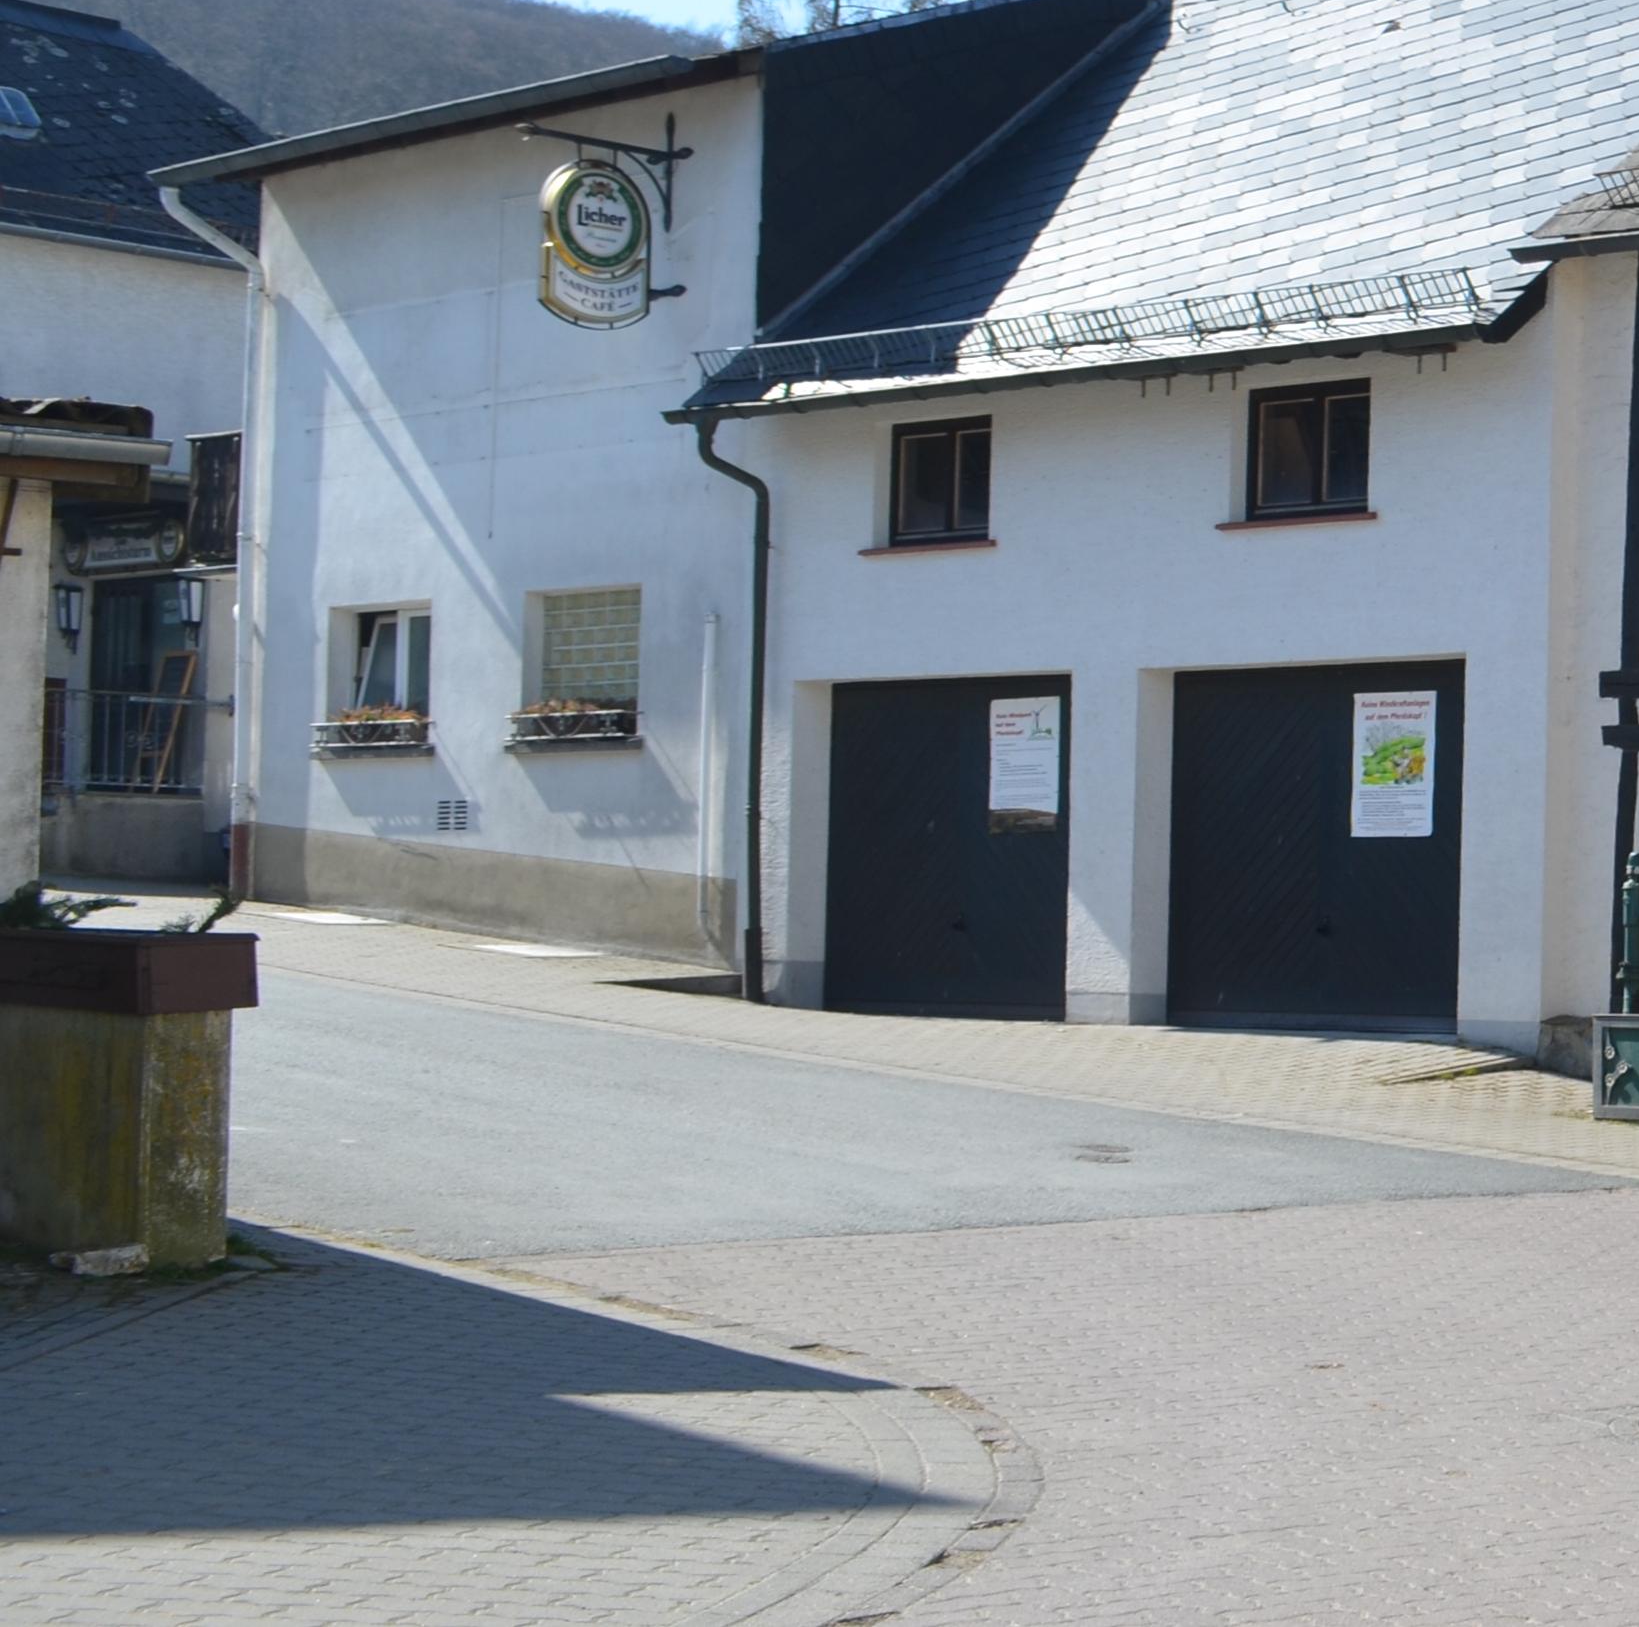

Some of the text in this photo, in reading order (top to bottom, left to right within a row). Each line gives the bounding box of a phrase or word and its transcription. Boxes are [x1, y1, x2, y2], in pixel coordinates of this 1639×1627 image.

[576, 203, 627, 227] Licher
[558, 271, 640, 298] GASTSTÄTTE
[580, 297, 616, 312] CAFÉ
